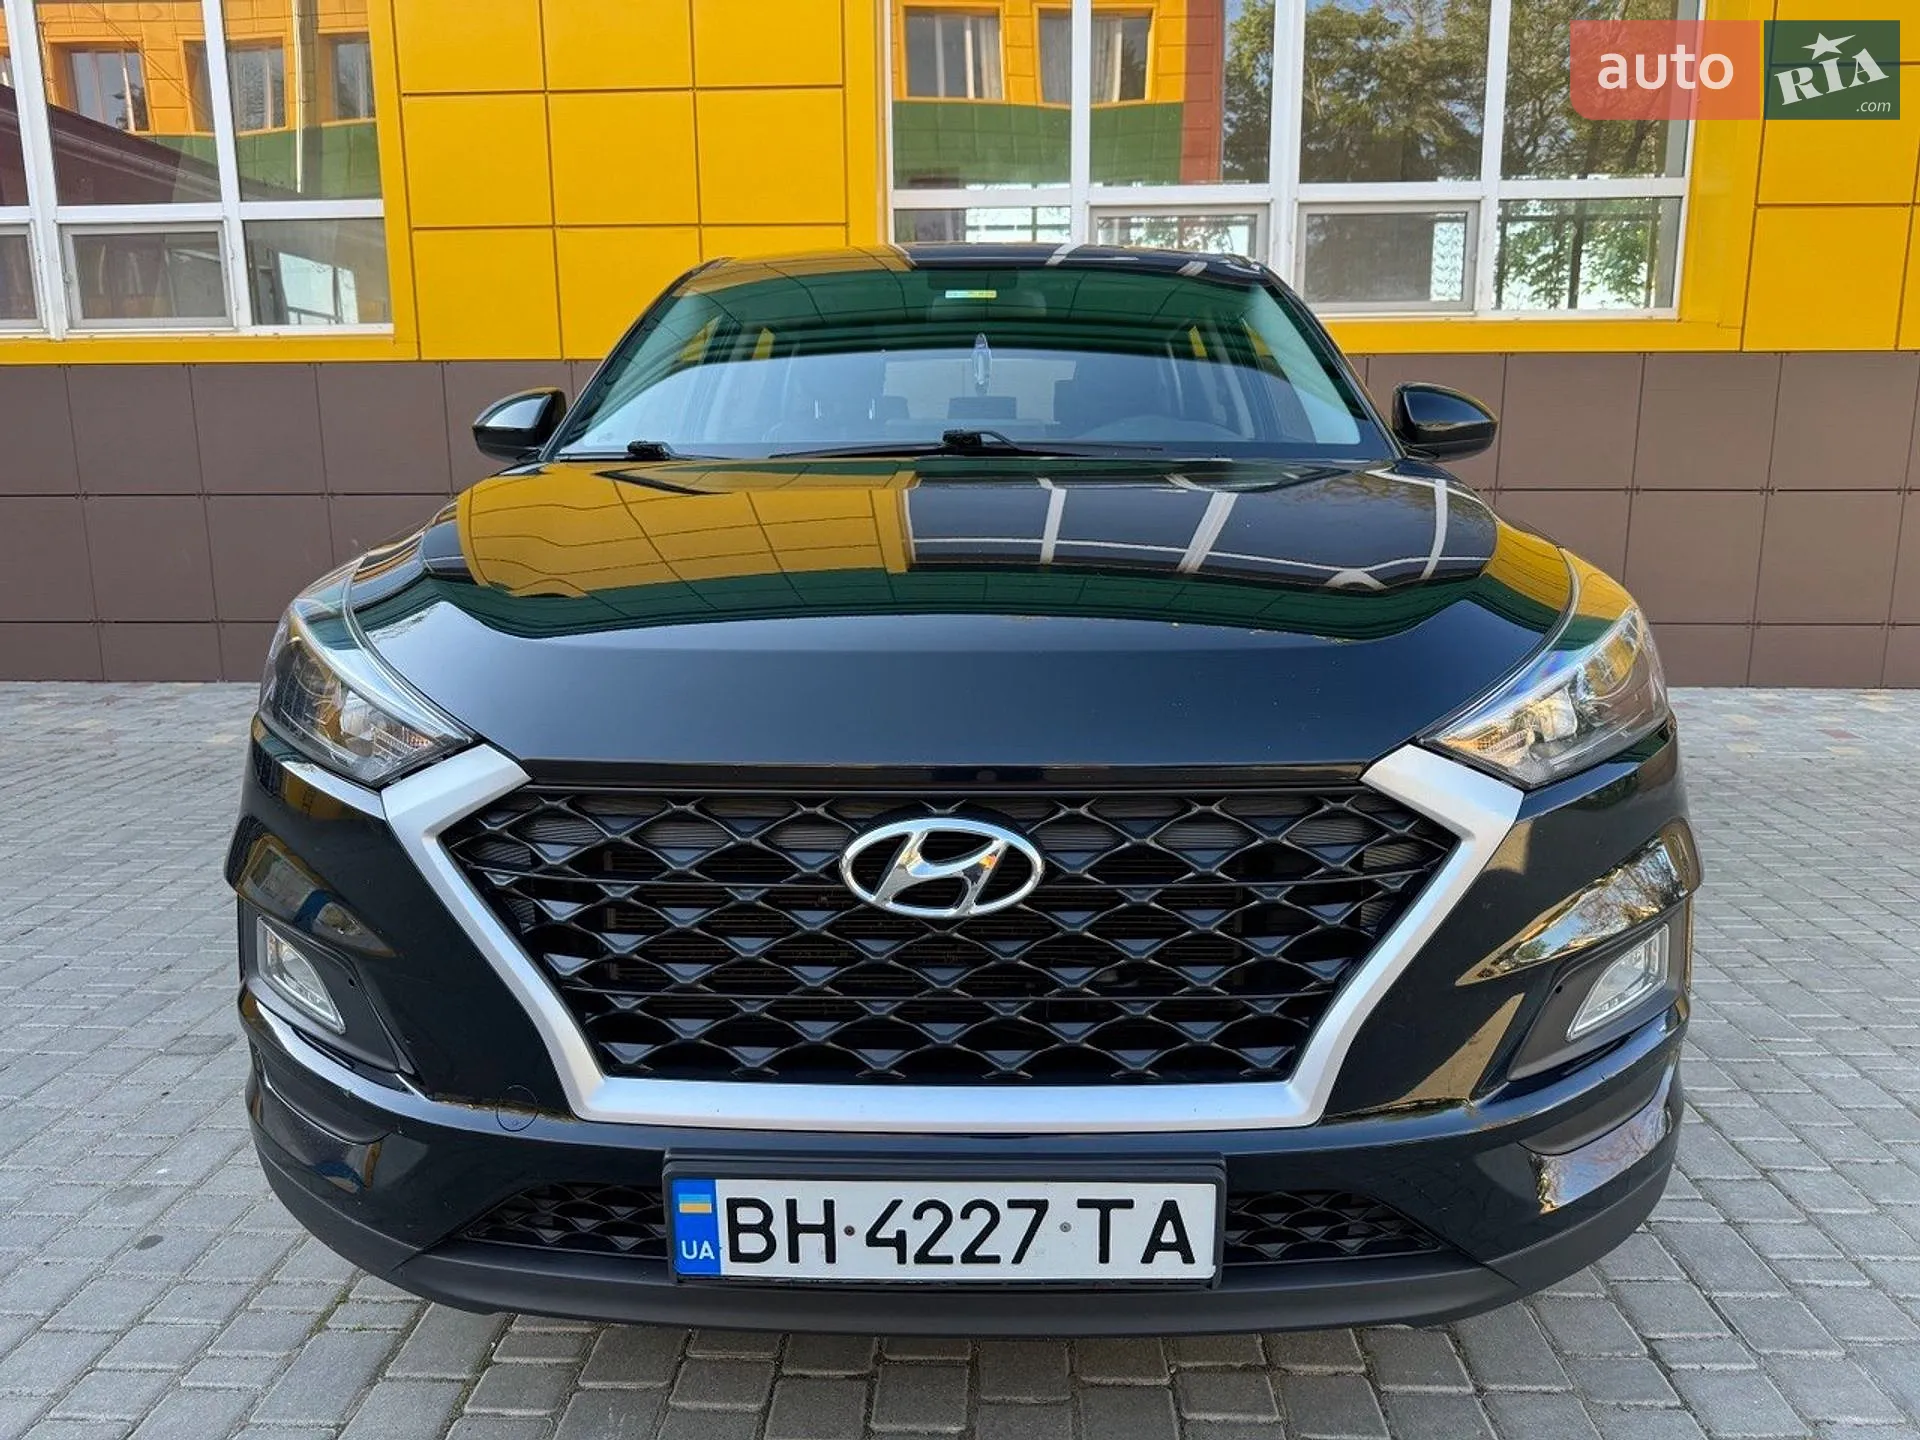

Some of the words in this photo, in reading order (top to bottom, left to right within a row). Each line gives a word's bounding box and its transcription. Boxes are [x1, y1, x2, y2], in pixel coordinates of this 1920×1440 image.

[681, 1240, 715, 1260] UA
[726, 1198, 836, 1265] BH
[864, 1198, 1049, 1265] 4227
[1077, 1198, 1195, 1265] TA
